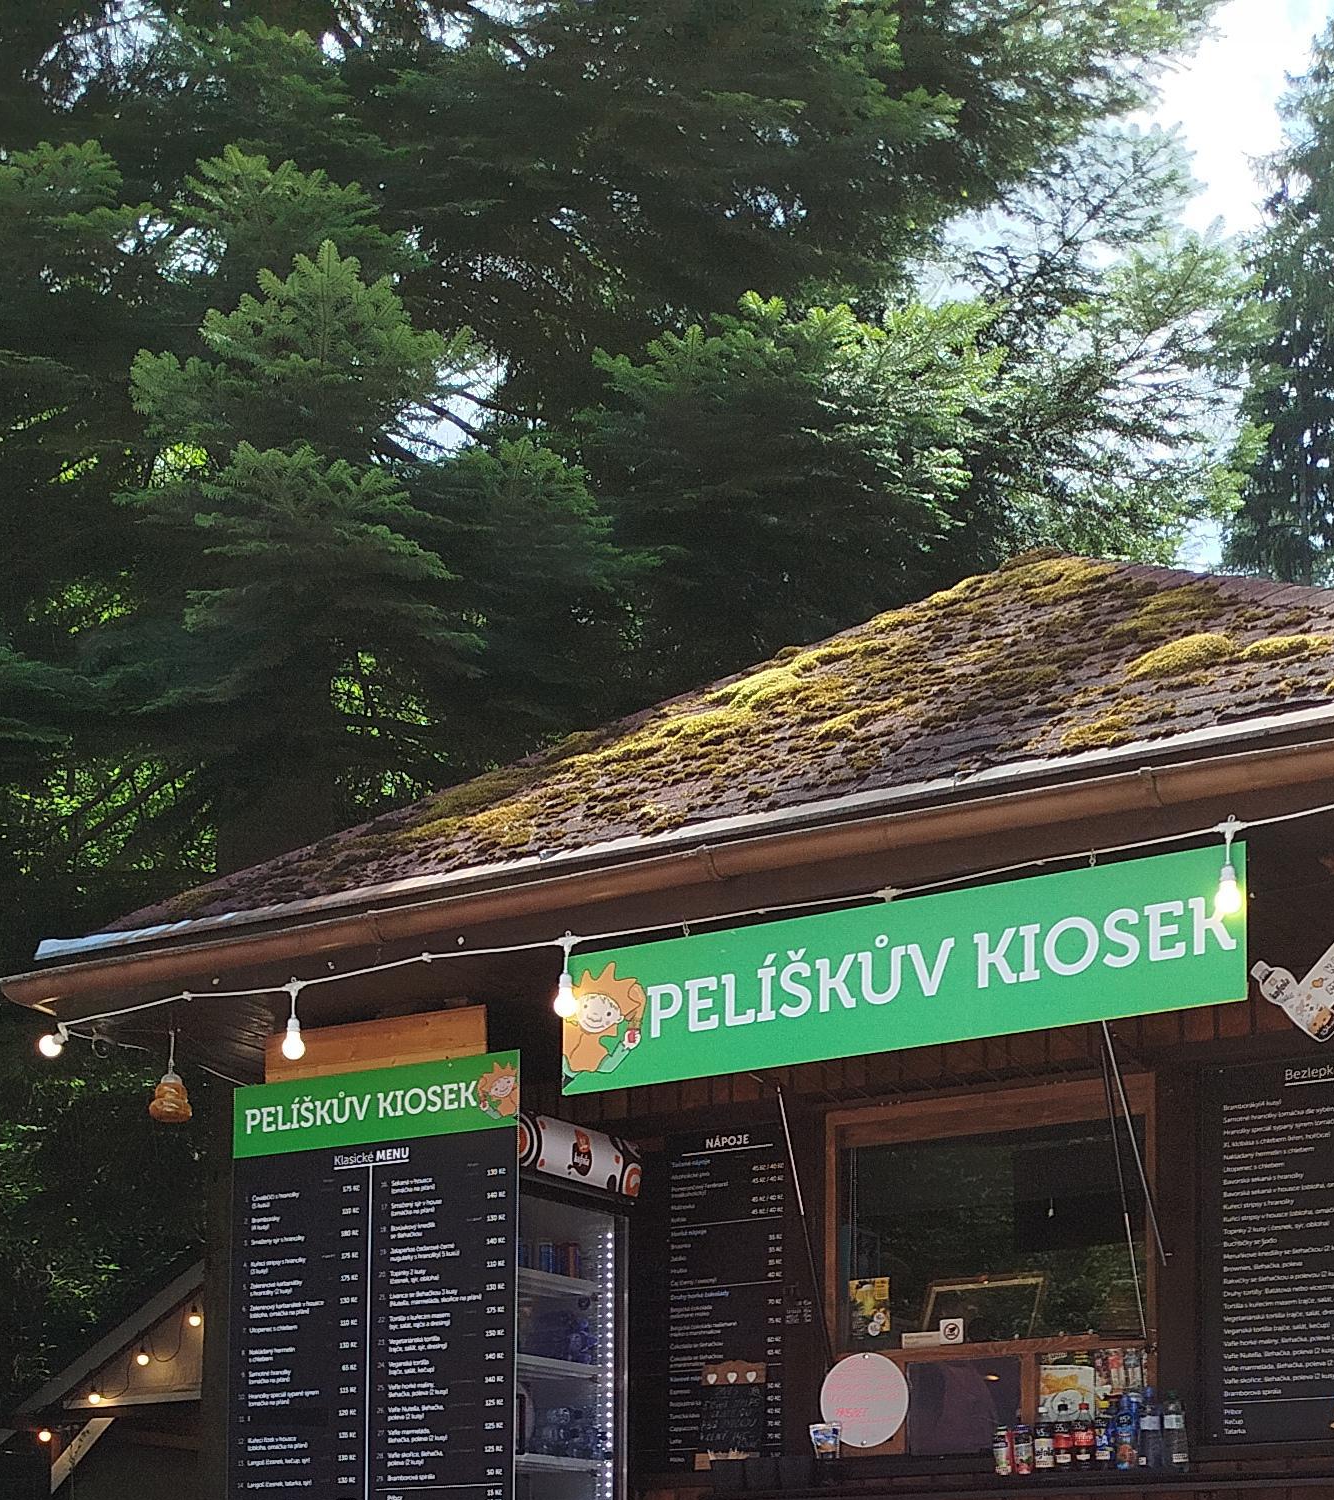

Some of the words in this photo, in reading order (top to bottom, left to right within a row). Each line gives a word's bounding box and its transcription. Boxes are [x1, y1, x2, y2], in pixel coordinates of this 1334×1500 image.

[647, 934, 955, 1039] PELÍŠKŮV
[973, 896, 1237, 989] KIOSEK
[245, 1091, 371, 1135] PELÍŠKŮV
[378, 1080, 477, 1119] KIOSEK
[333, 1151, 374, 1166] Klasické
[375, 1147, 410, 1161] MENU
[705, 1133, 750, 1149] NÁPOJE
